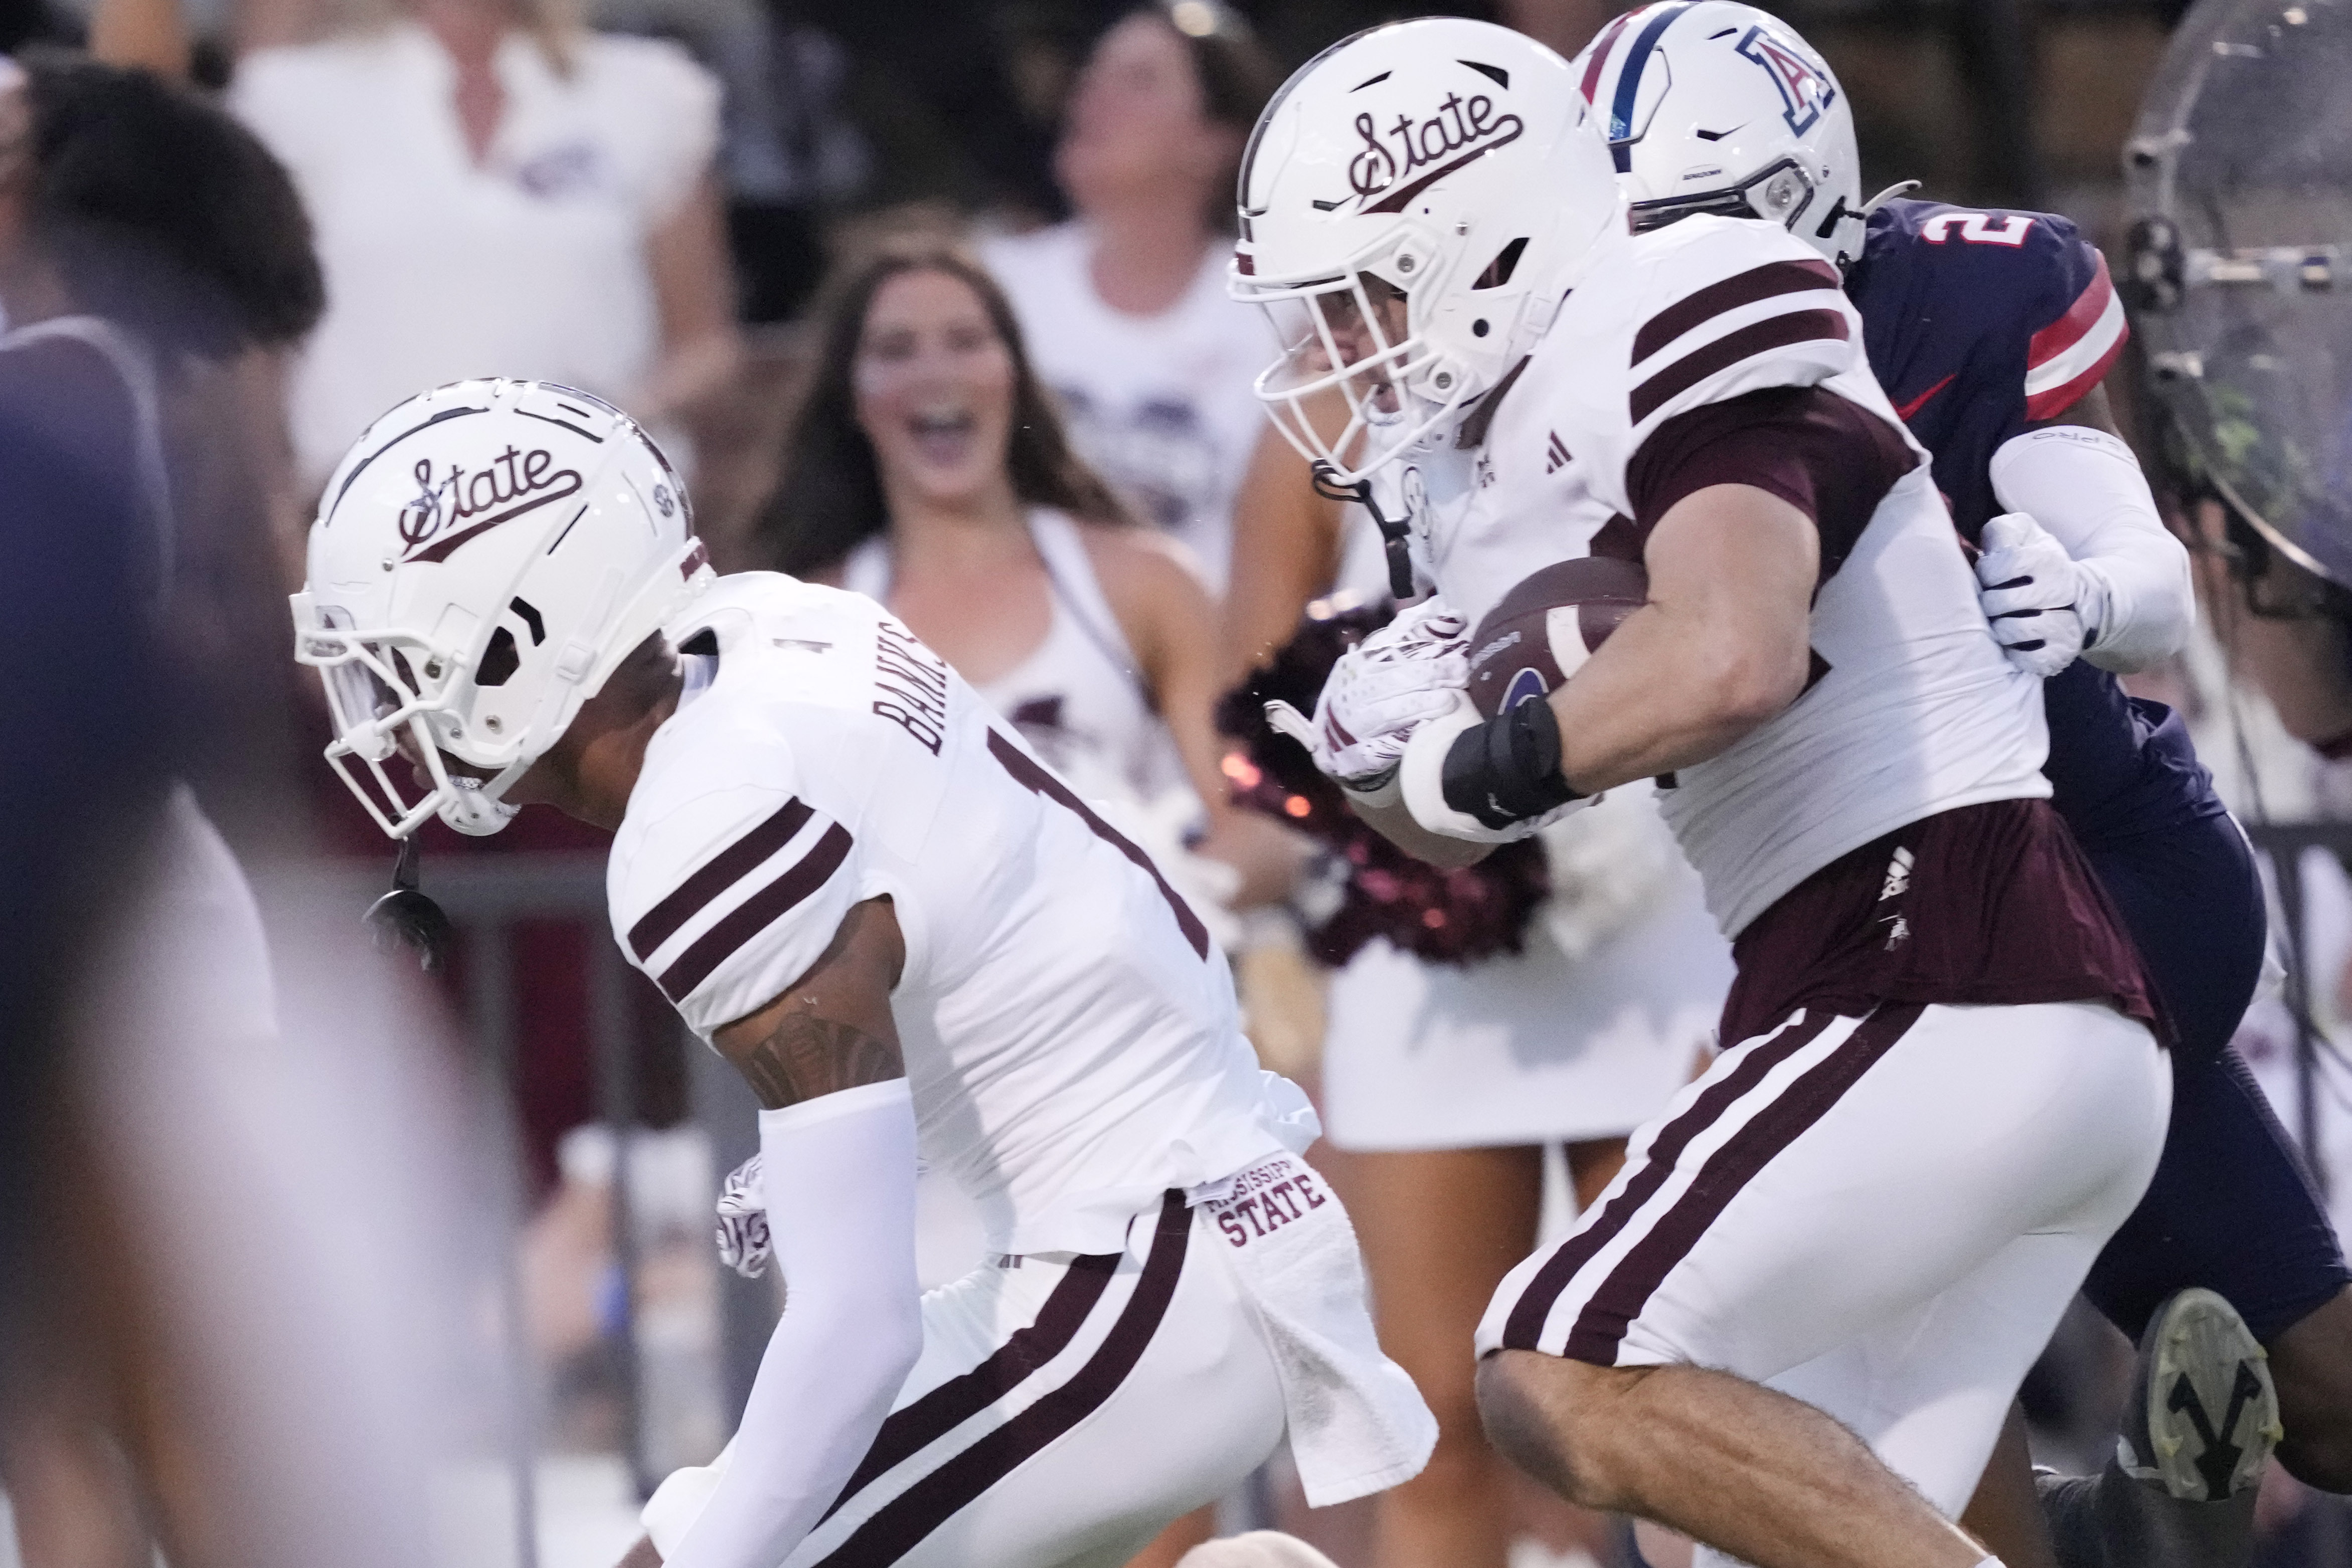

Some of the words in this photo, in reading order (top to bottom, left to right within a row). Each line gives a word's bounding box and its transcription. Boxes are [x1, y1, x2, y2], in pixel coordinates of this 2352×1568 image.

[1735, 25, 1835, 138] A
[1349, 92, 1524, 215] State
[1921, 213, 2035, 249] 2
[399, 444, 582, 563] State
[1218, 1174, 1326, 1248] STATE
